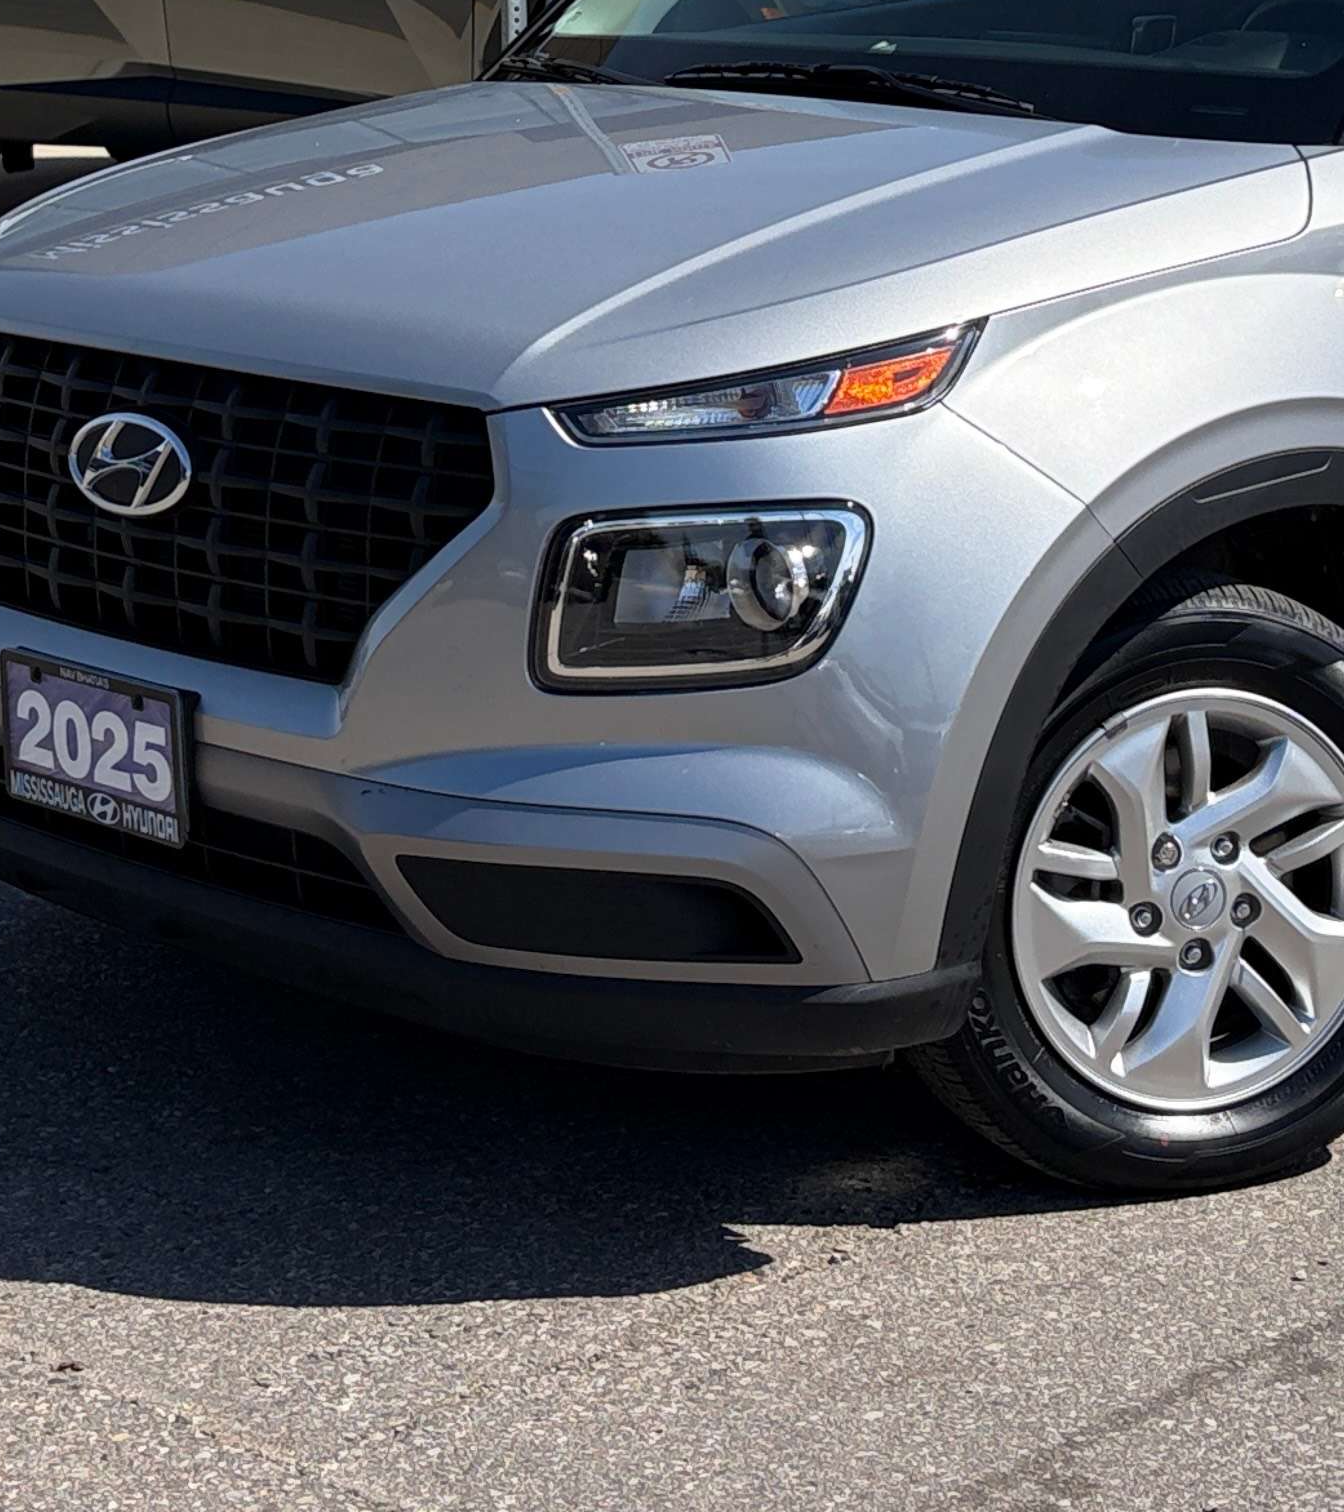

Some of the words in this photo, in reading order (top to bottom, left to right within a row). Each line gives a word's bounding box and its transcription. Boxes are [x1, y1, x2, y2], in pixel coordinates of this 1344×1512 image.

[16, 689, 172, 802] 2025
[10, 768, 87, 815] MISSISSAUGA
[122, 802, 179, 843] HYUNDAI
